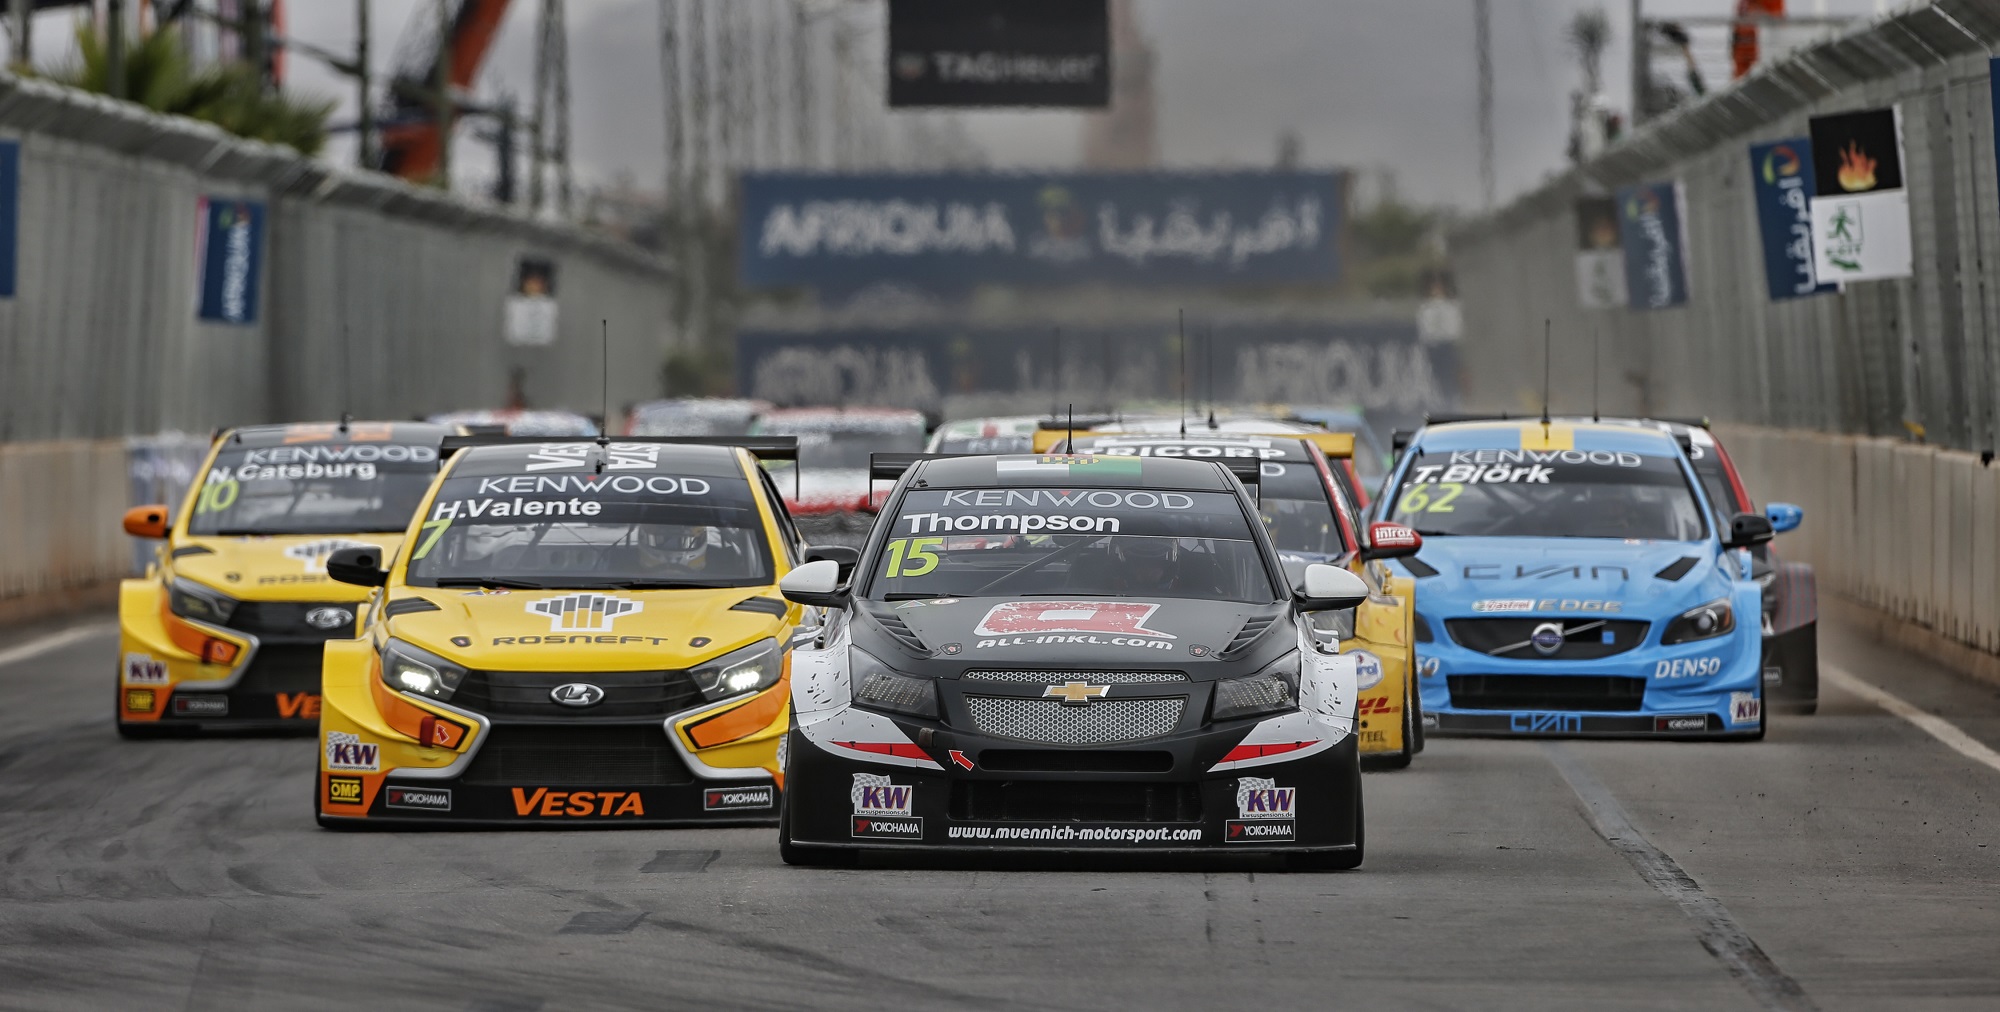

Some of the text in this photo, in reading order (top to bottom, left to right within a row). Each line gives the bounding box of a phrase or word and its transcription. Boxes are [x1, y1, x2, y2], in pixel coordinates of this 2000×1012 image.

[242, 444, 438, 464] KENWOOD
[1449, 449, 1642, 468] KENWOOD
[478, 475, 711, 495] KENWOOD
[196, 480, 239, 515] 10
[942, 489, 1194, 509] KENWOOD
[1399, 483, 1465, 513] 62
[433, 498, 602, 521] H.Valente
[903, 513, 1120, 534] Thompson
[412, 518, 453, 561] 7
[885, 537, 943, 579] 15
[1538, 598, 1625, 612] EDGE
[493, 634, 669, 646] ROSNEFT
[131, 662, 166, 679] KW
[1655, 656, 1721, 679] DENSO
[1358, 696, 1391, 715] HL
[1736, 701, 1760, 718] KW
[334, 743, 379, 765] KW
[330, 783, 361, 797] OMP
[402, 792, 448, 806] YOKOHAMA
[722, 792, 769, 805] YOKOHAMA
[862, 786, 911, 810] KW
[511, 787, 645, 816] VESTA
[1248, 789, 1295, 813] KW
[856, 809, 910, 817] kwsuspensions.de
[870, 821, 919, 834] YOKOHAMA
[948, 825, 1202, 843] www.muennich-motorsport.com
[1244, 824, 1292, 836] YOKOHAMA
